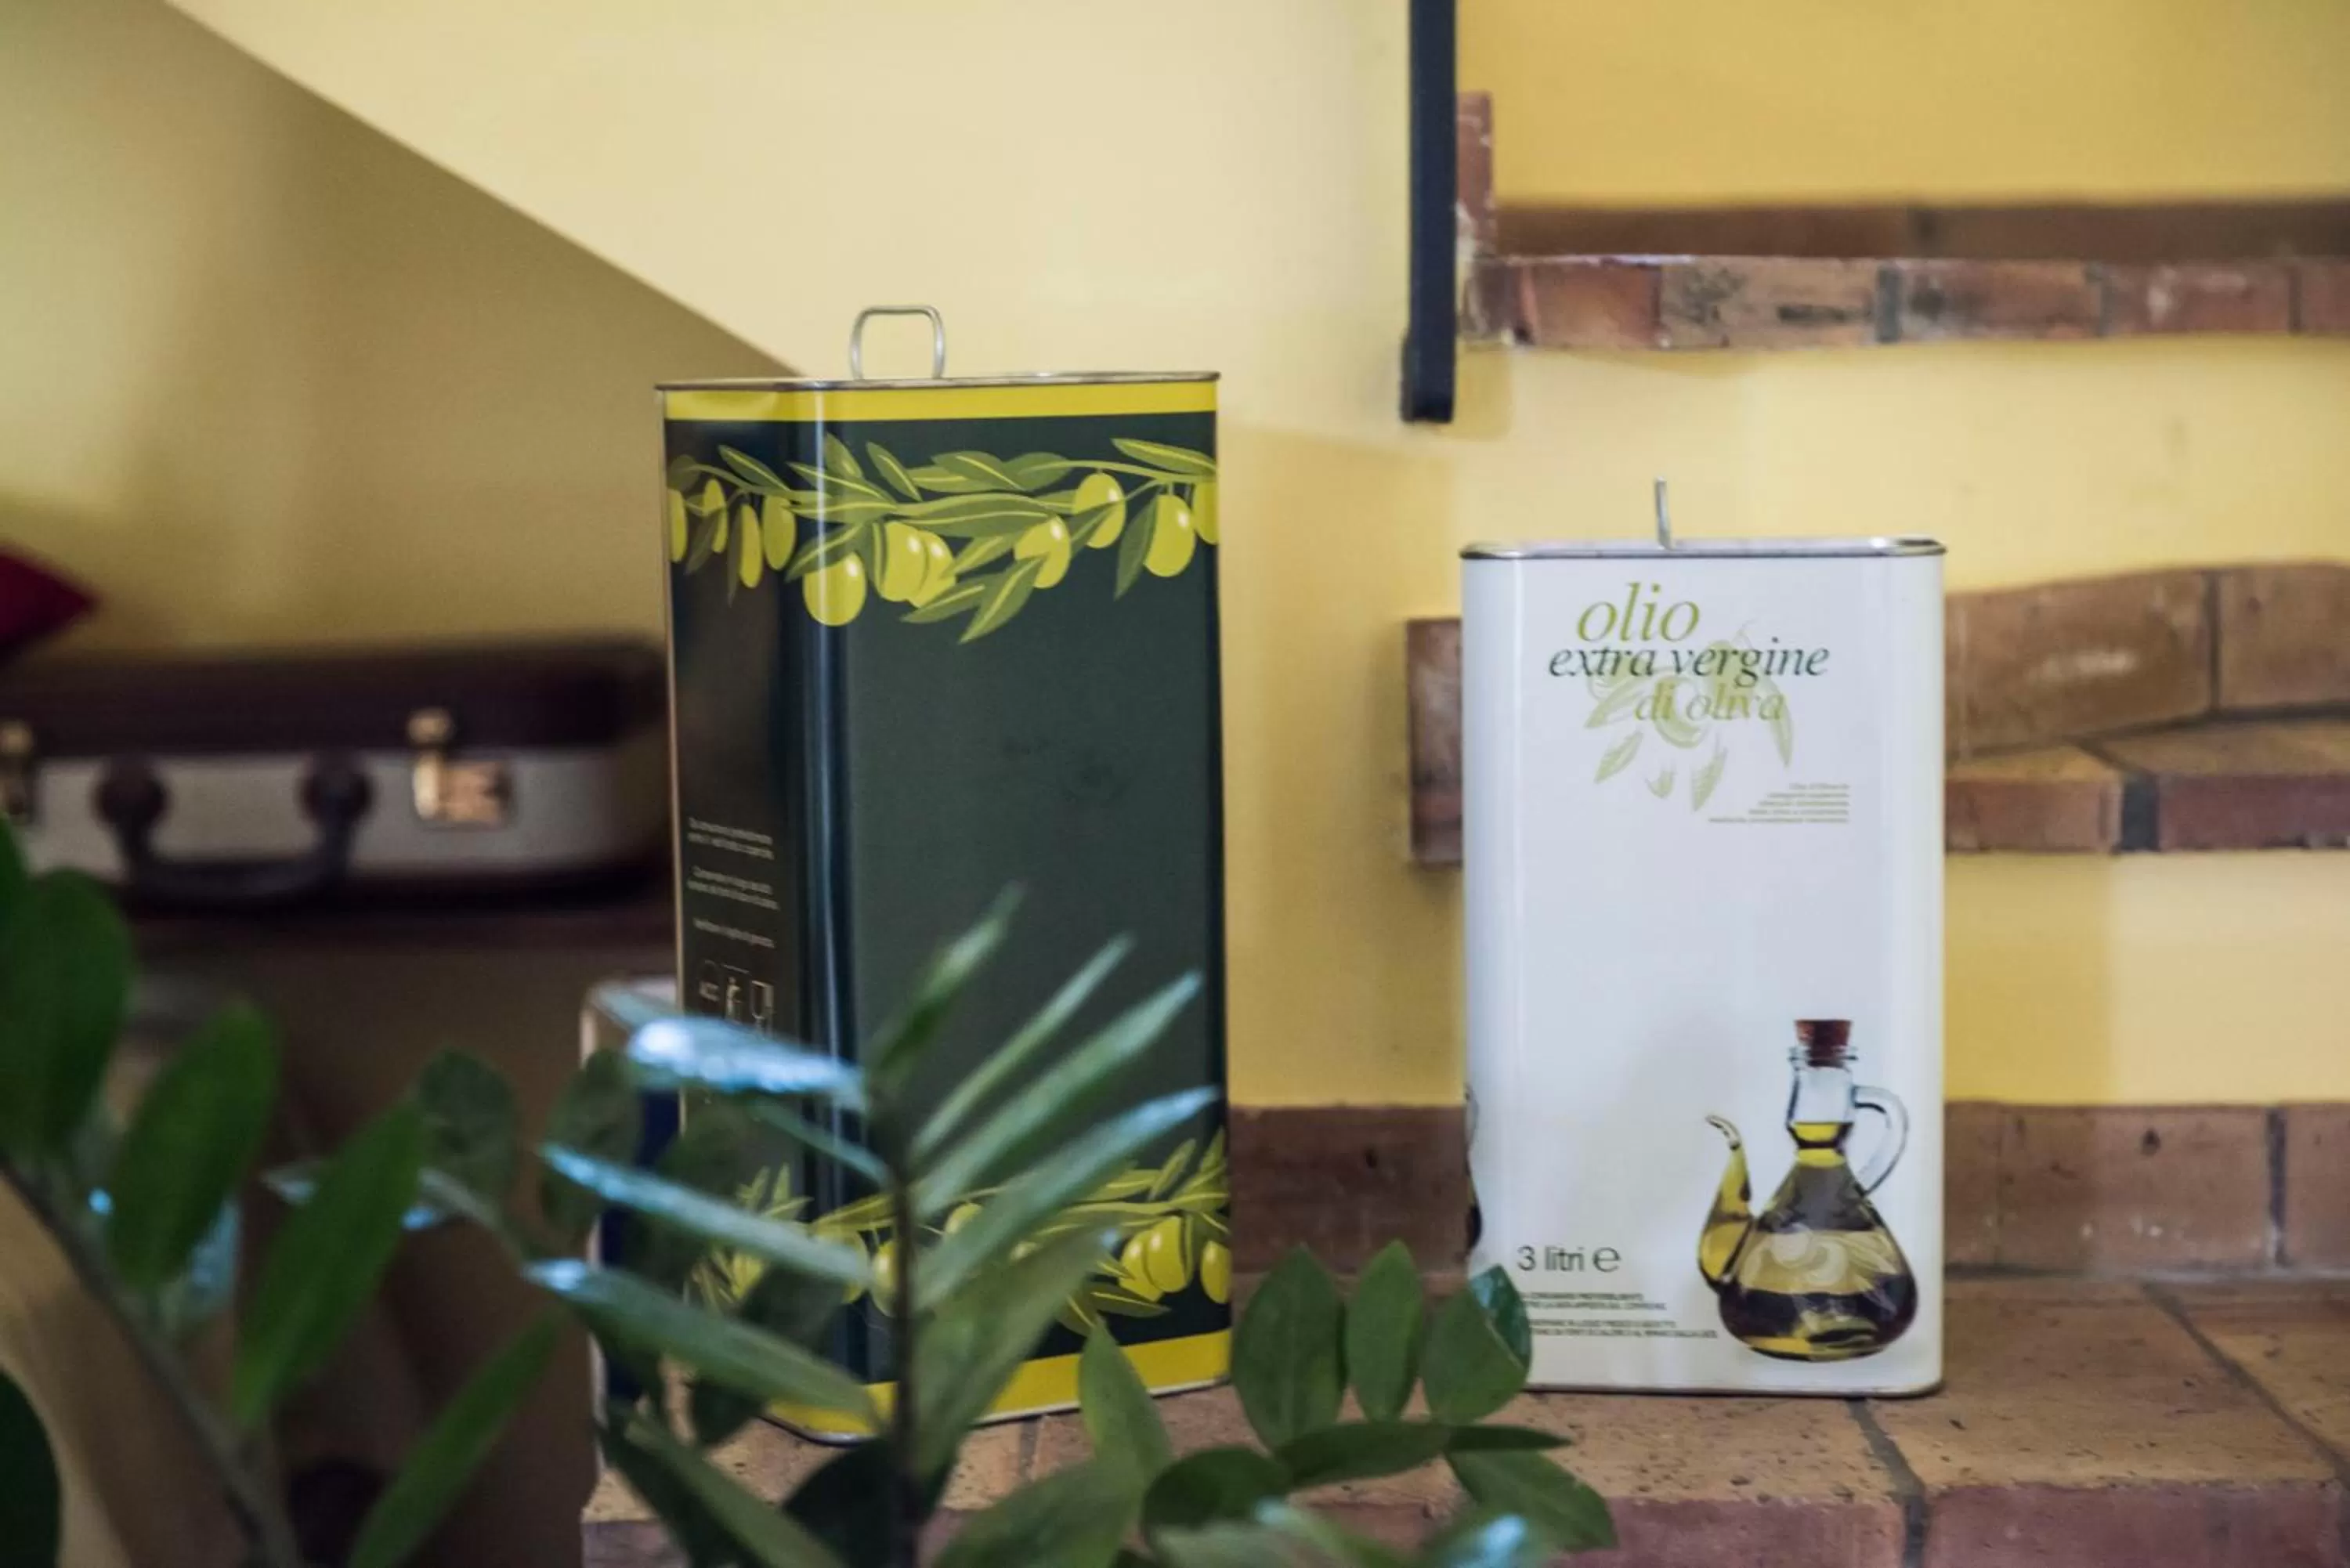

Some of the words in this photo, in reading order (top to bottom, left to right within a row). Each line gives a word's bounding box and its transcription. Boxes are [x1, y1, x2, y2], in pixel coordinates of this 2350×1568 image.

[1576, 582, 1700, 641] olio
[1548, 644, 1658, 677] extra
[1669, 636, 1830, 688] vergine
[1635, 681, 1677, 721] di
[1685, 682, 1785, 721] oliva
[1517, 1245, 1536, 1271] 3
[1544, 1245, 1585, 1271] litri
